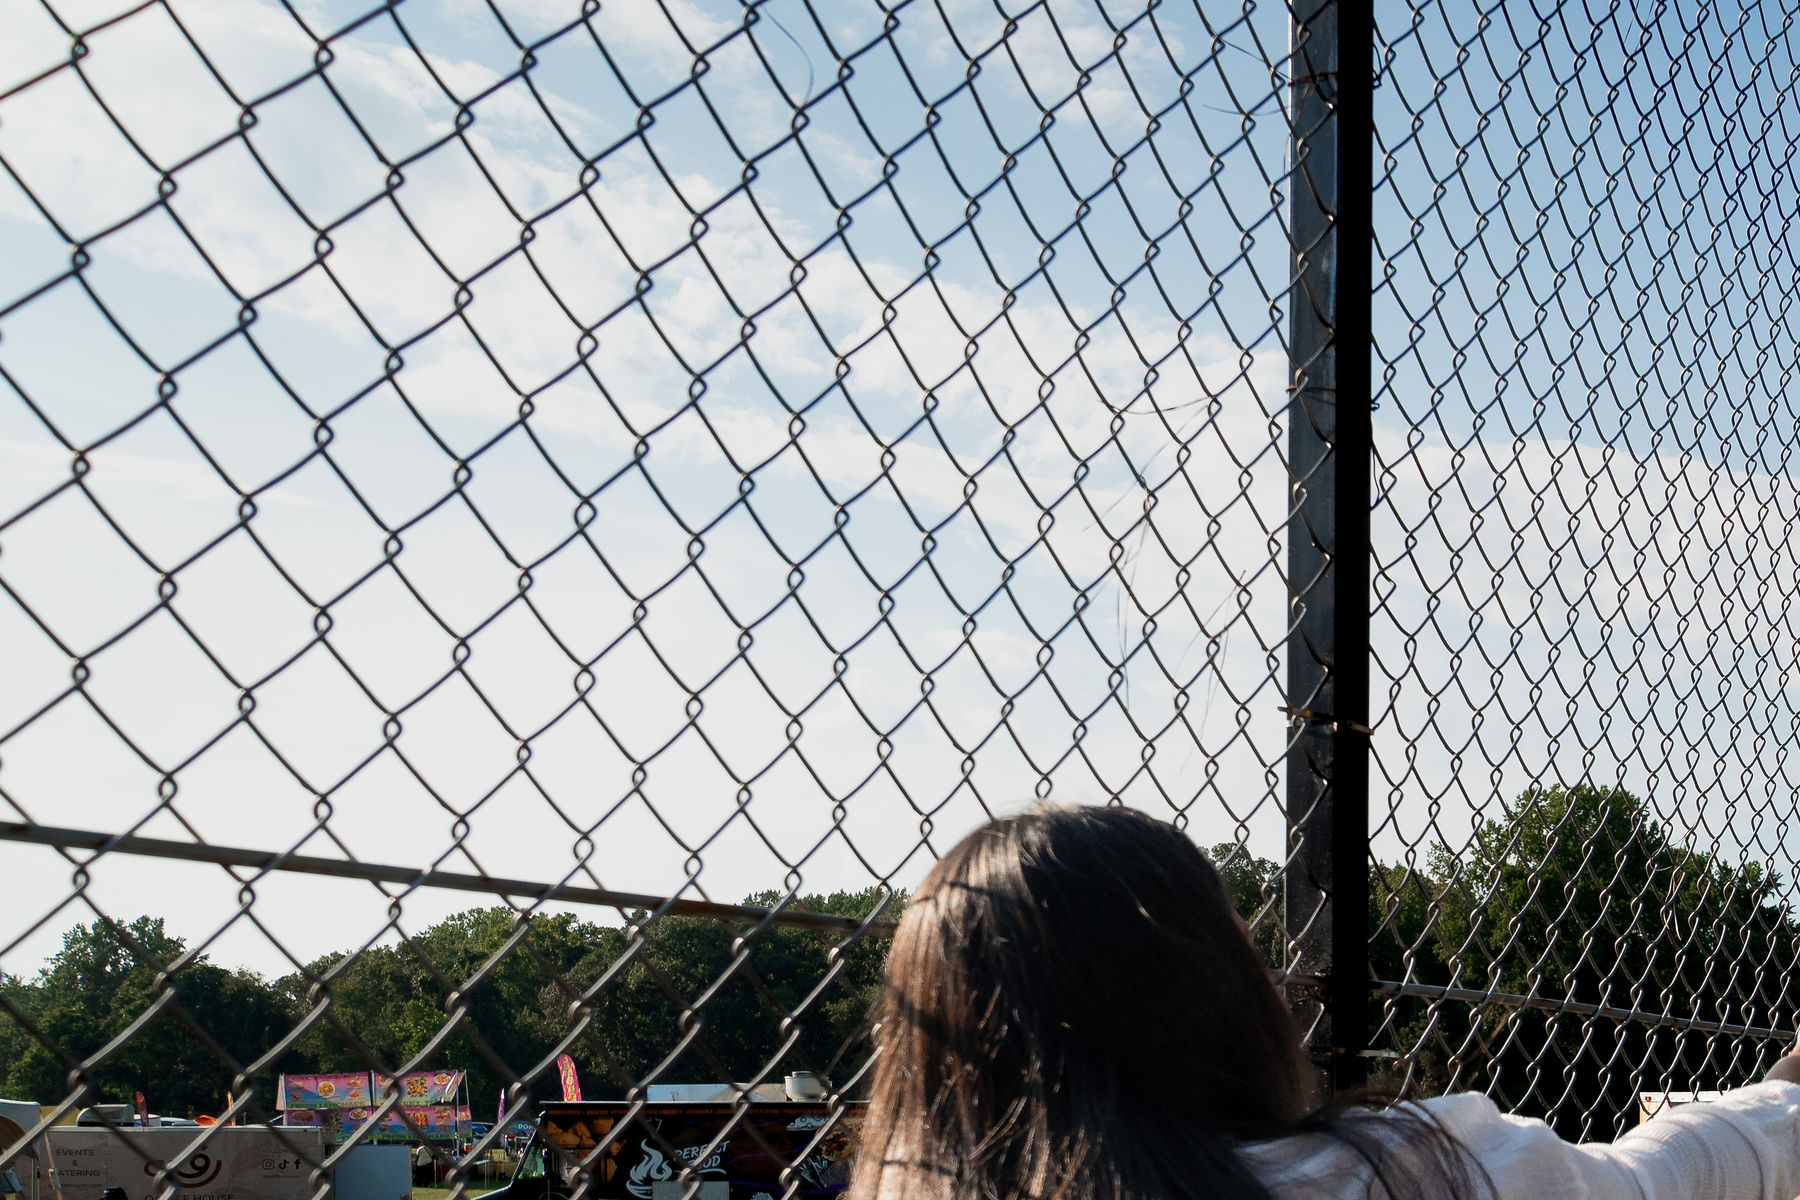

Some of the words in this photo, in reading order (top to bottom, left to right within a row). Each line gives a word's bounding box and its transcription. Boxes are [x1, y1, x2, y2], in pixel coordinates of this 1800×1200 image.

[674, 1140, 730, 1161] PERFCT
[688, 1155, 720, 1168] FOD
[57, 1169, 100, 1177] ATERING
